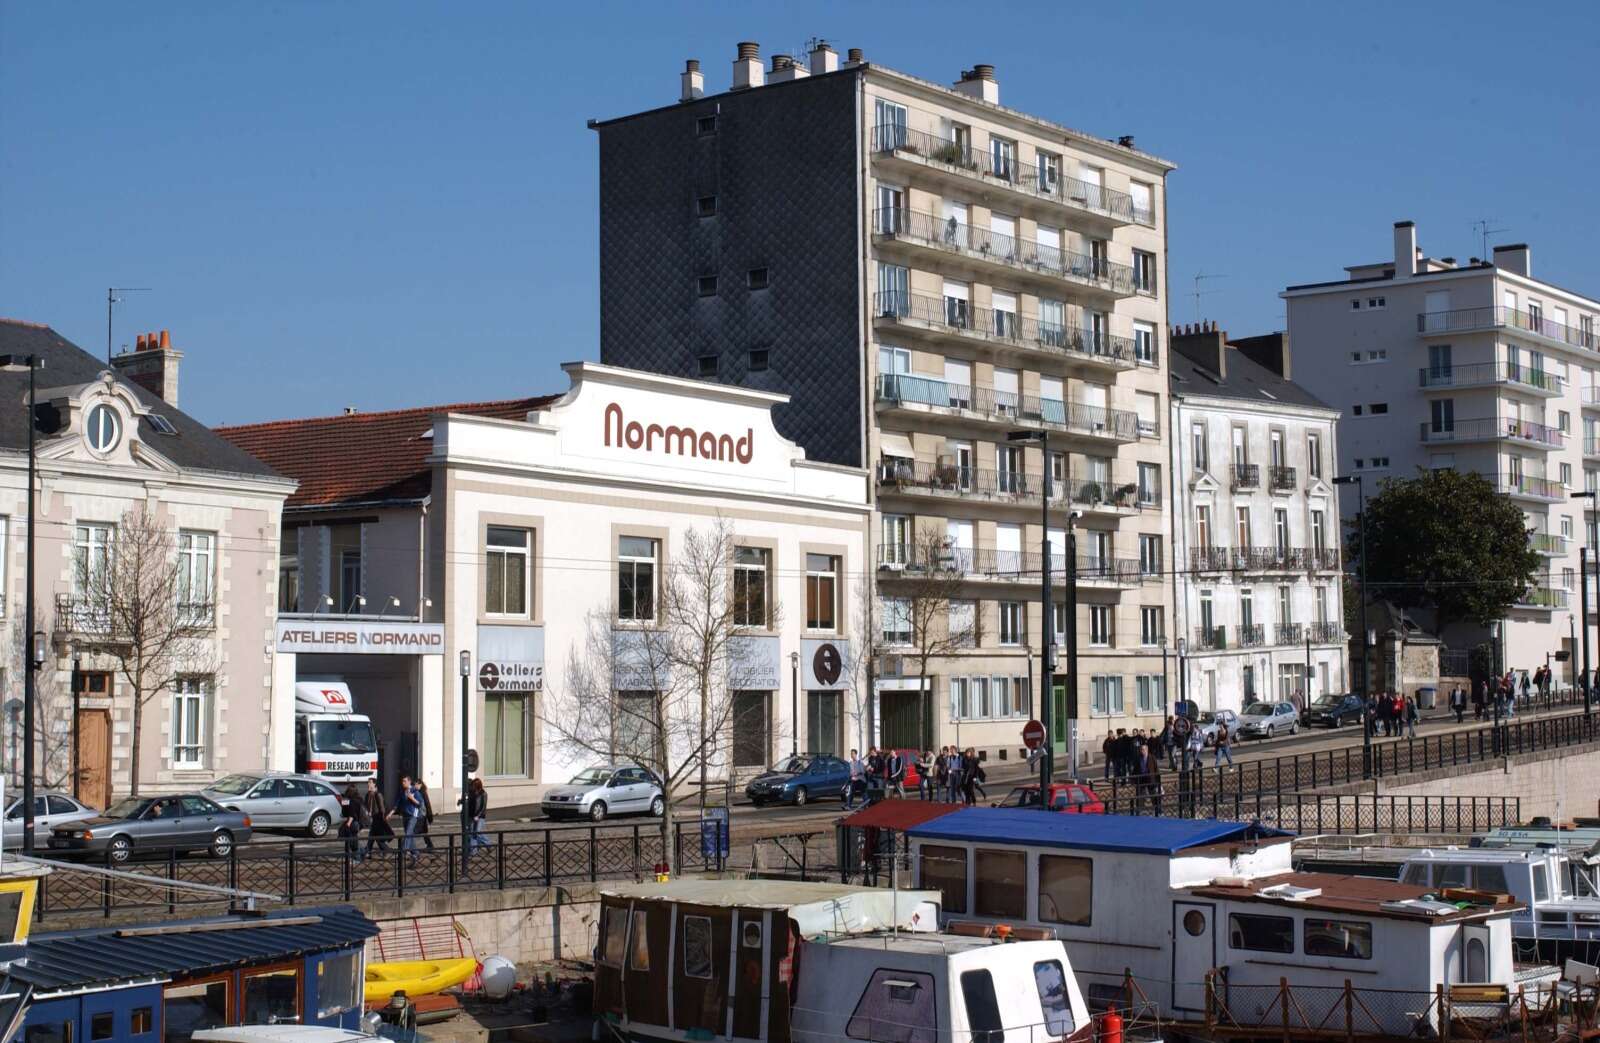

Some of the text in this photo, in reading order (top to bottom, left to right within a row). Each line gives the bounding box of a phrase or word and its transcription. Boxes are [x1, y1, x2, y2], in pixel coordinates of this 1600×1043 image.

[604, 402, 753, 464] Normand
[281, 630, 442, 646] ATELIERS NORMAND
[479, 662, 542, 676] Ateliers
[479, 677, 542, 690] Normand
[327, 761, 370, 770] RESEAU PRO
